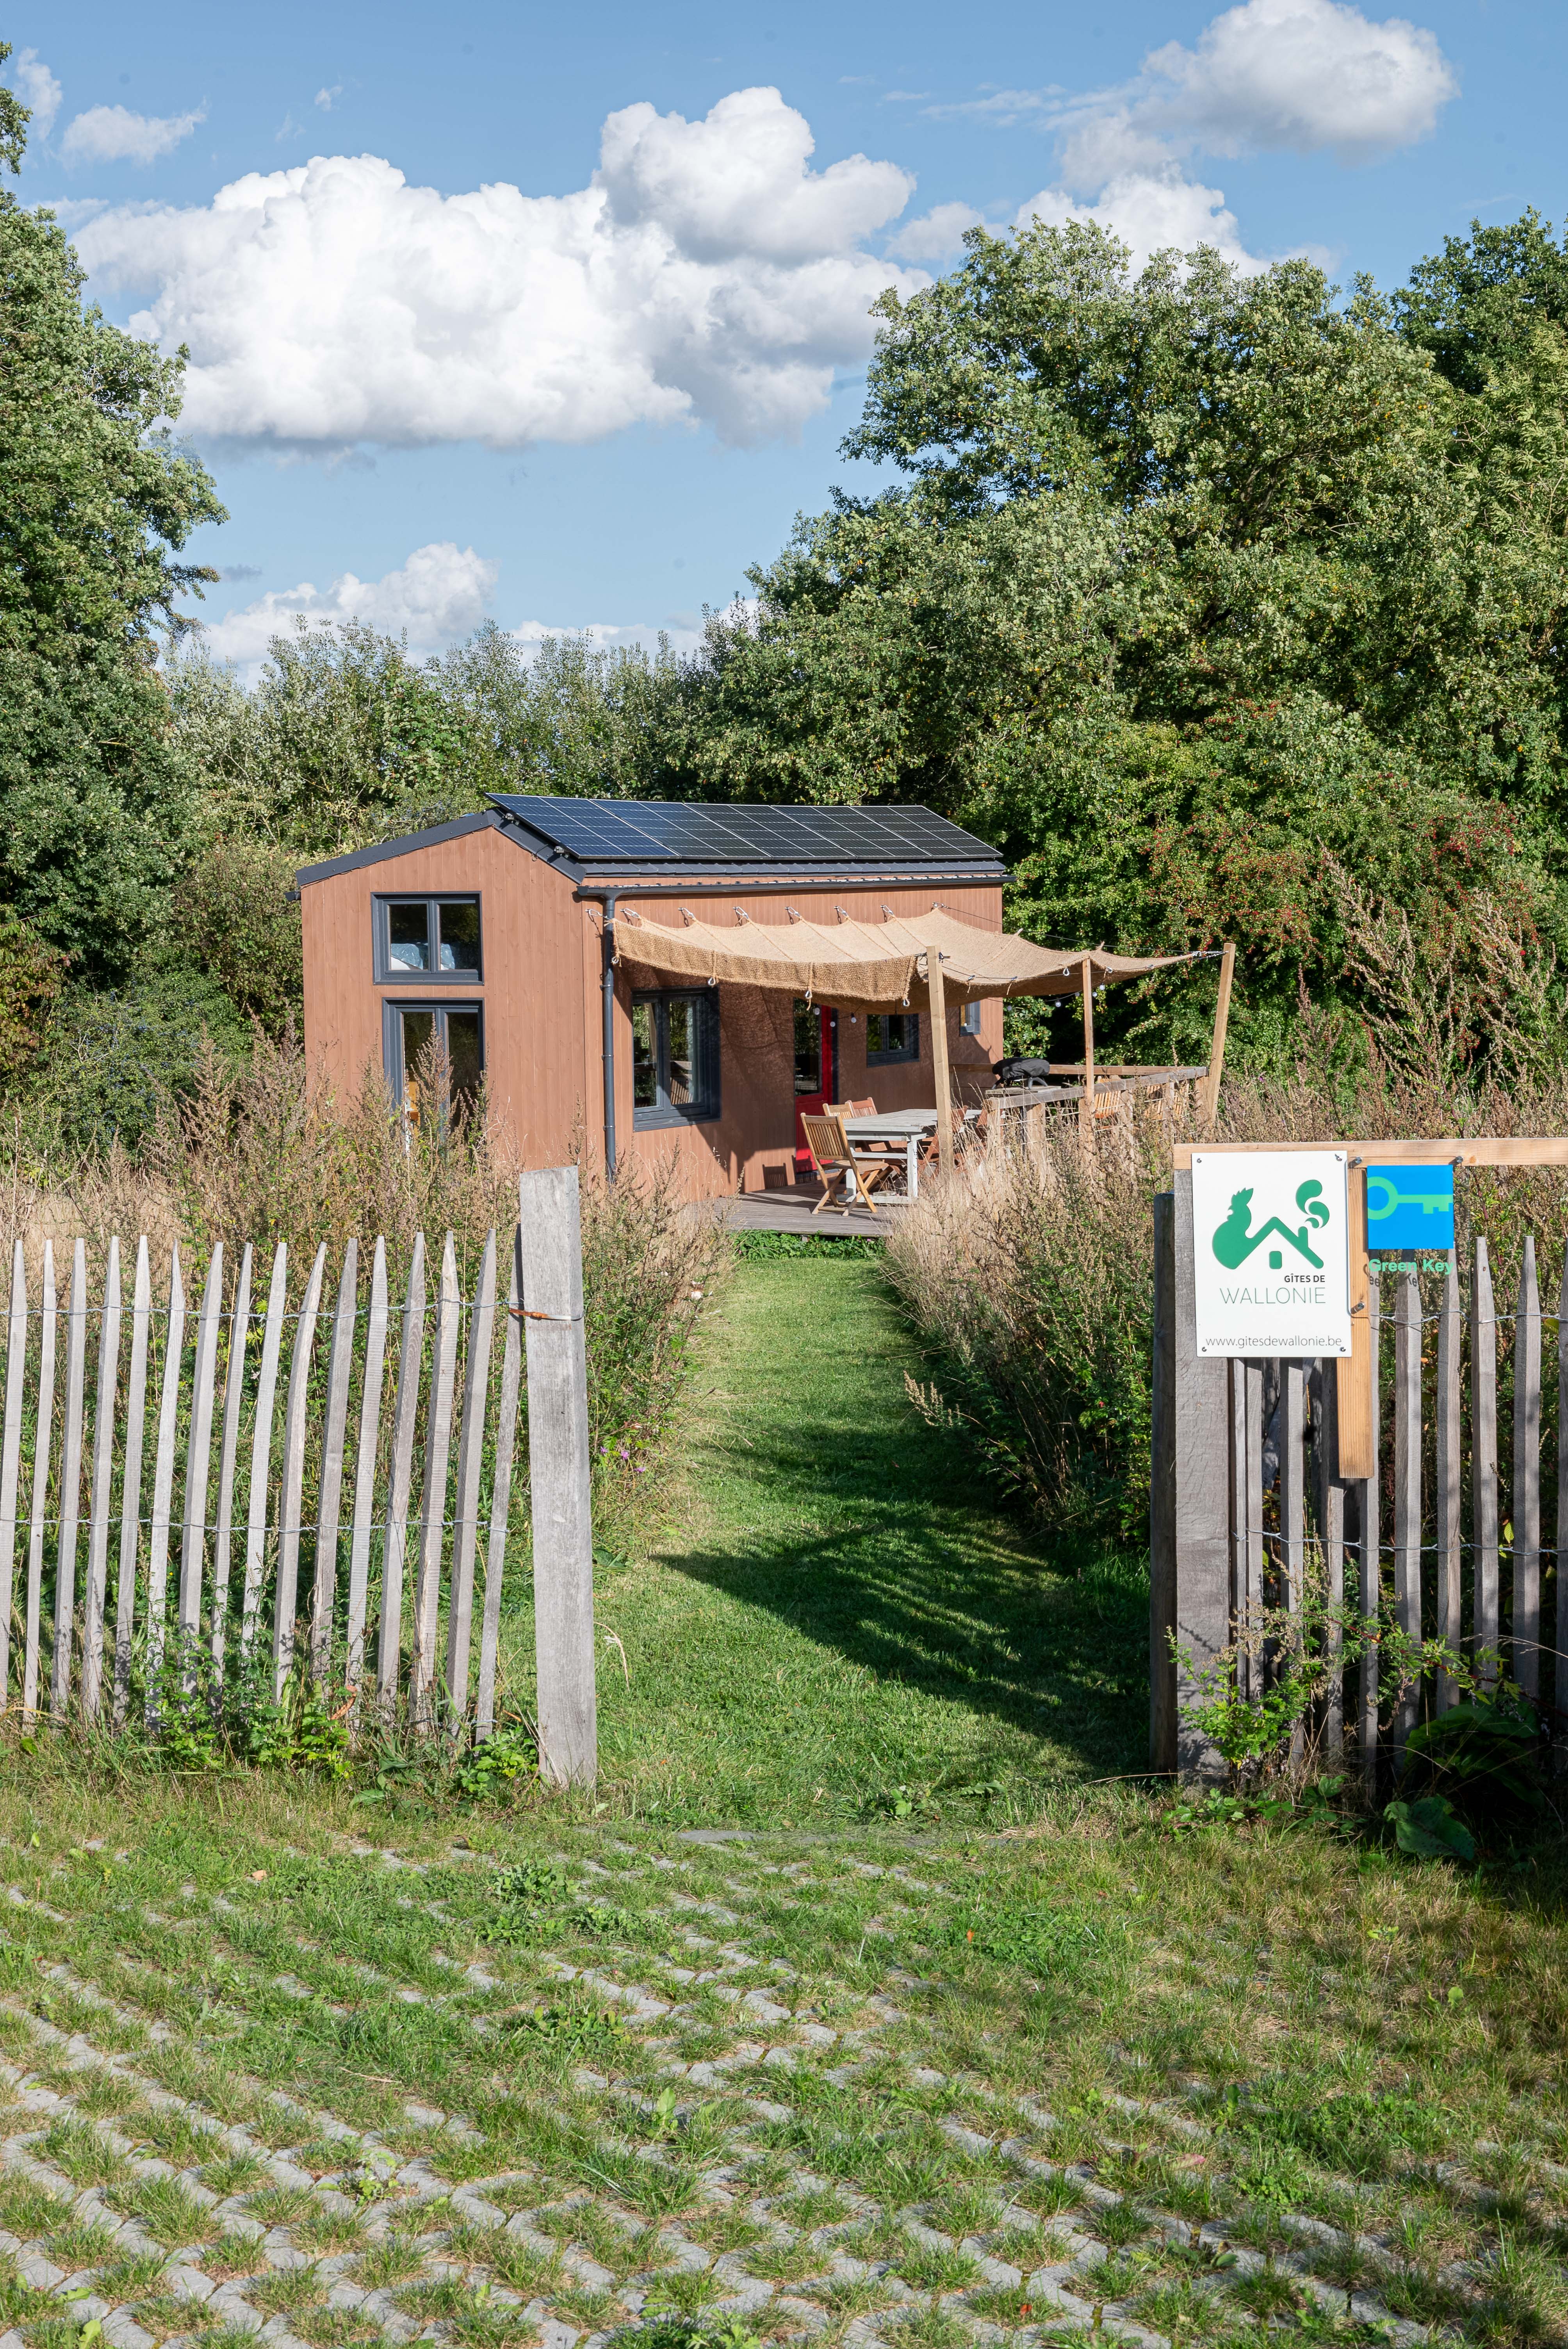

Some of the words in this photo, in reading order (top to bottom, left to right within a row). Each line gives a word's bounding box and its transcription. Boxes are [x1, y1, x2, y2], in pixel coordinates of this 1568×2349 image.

[1368, 1258, 1417, 1272] Green
[1423, 1259, 1454, 1275] Key
[1284, 1273, 1311, 1283] GÎTES
[1219, 1287, 1326, 1304] WALLONIE
[1206, 1335, 1342, 1349] www.gitesdewallonie.be
